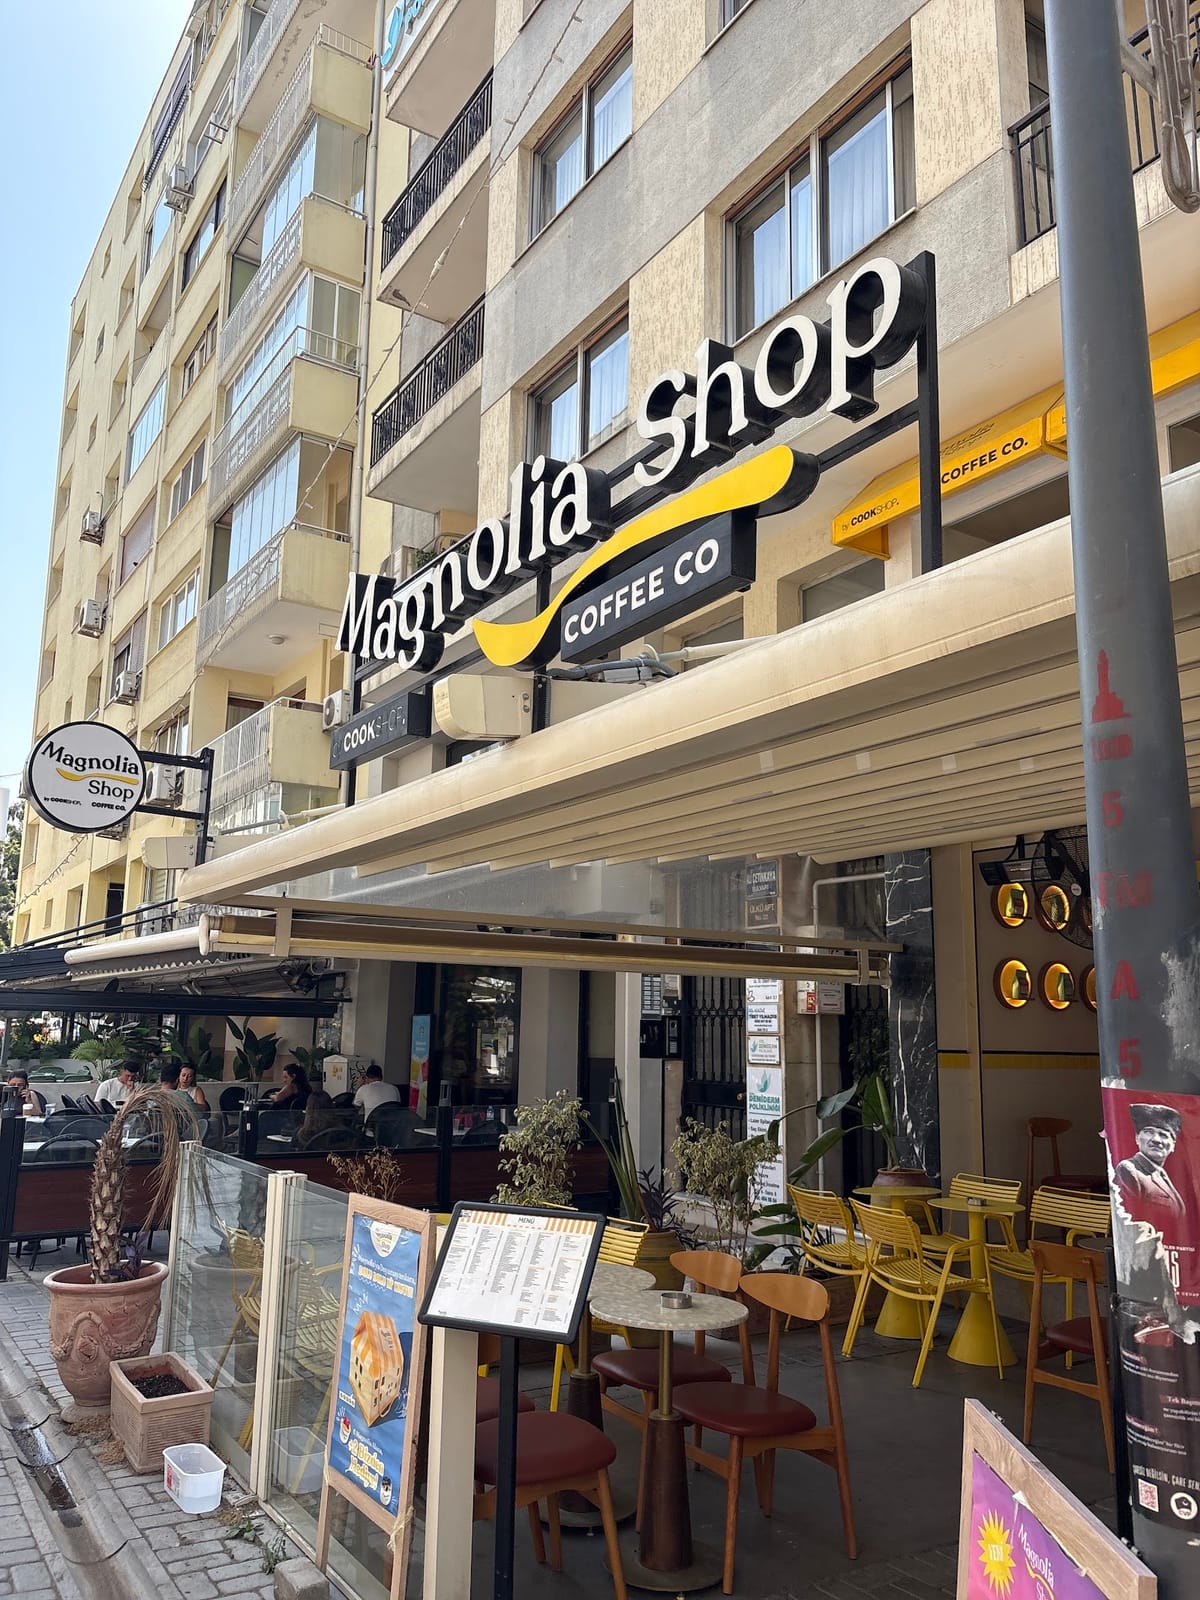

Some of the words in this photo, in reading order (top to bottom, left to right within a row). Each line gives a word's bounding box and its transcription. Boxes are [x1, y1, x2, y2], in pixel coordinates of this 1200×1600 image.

[335, 455, 592, 670] Magnolia
[633, 257, 901, 486] Shop
[941, 449, 997, 484] COFFEE
[1001, 437, 1028, 455] CO.
[564, 566, 665, 643] COFFEE
[673, 538, 719, 585] CO
[41, 740, 139, 776] Magnolia
[88, 779, 134, 802] Shop
[1103, 790, 1125, 829] 5
[1110, 959, 1141, 1003] A
[1118, 1038, 1142, 1079] 5
[1018, 1522, 1055, 1591] Magnolia
